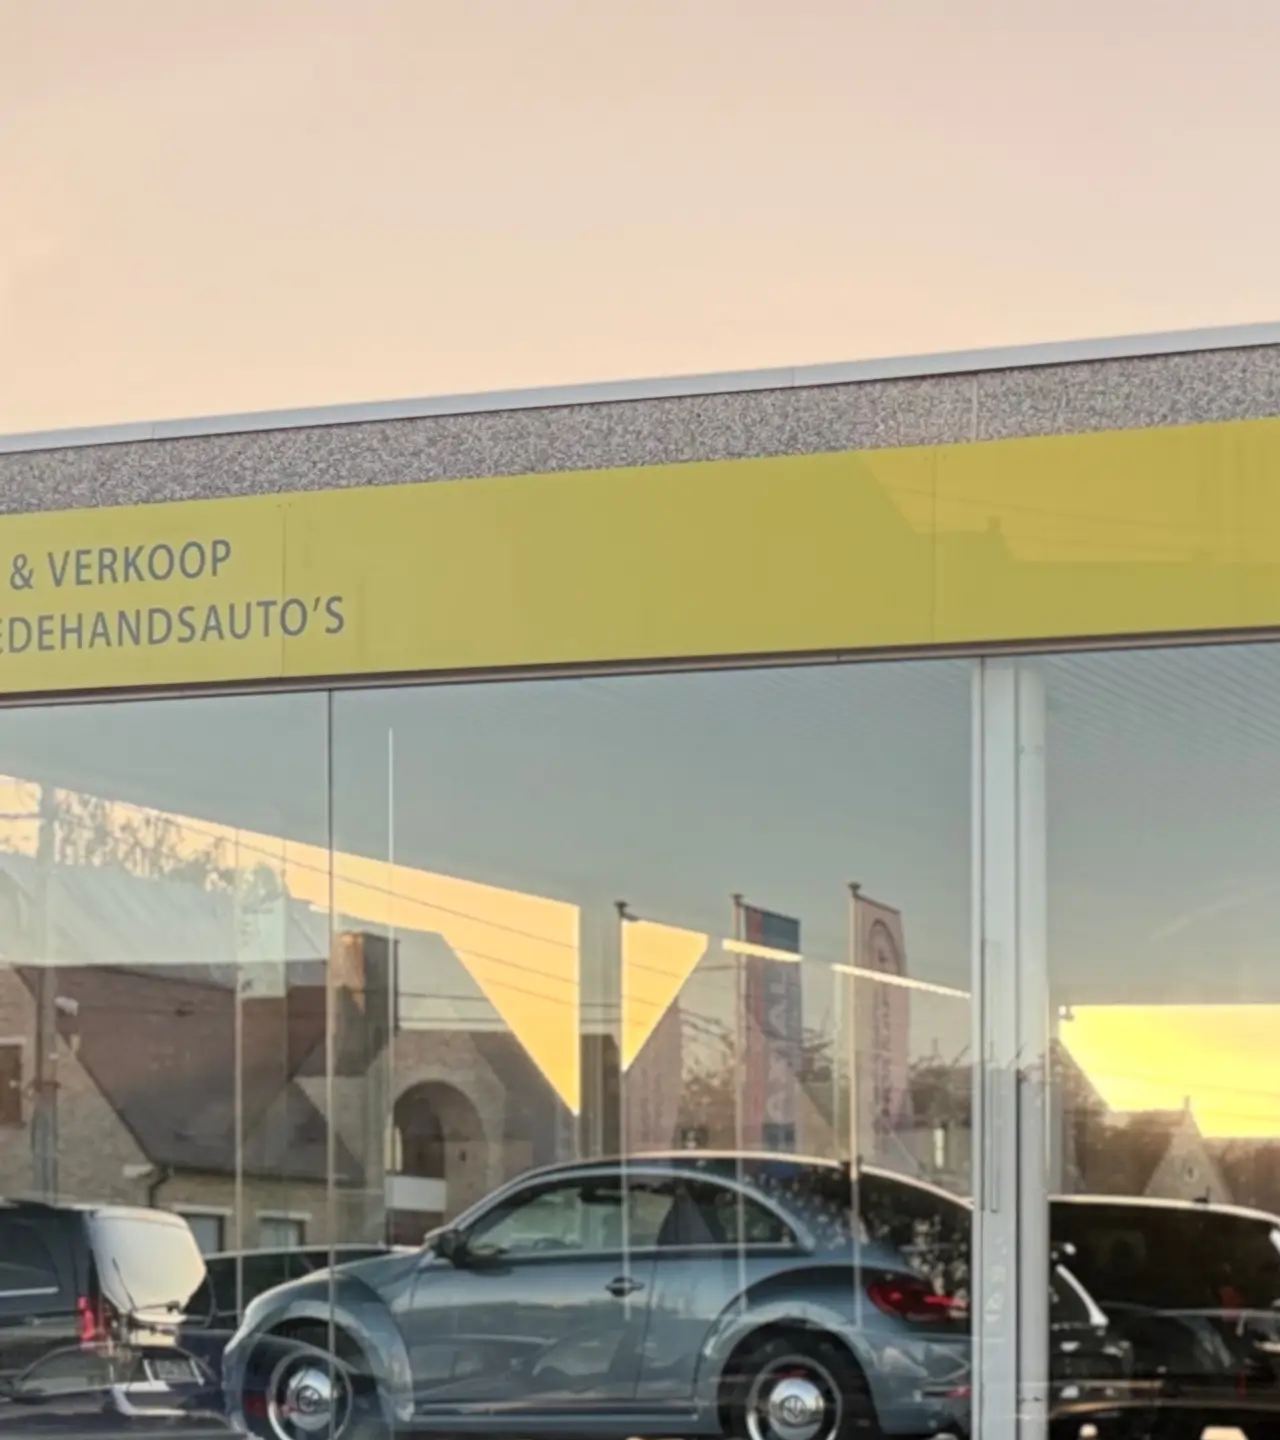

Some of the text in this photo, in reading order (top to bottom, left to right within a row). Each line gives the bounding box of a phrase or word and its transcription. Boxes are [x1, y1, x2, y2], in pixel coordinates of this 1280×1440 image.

[9, 539, 232, 591] & VERKOOP
[0, 595, 345, 653] DEHANDSAUTO'S
